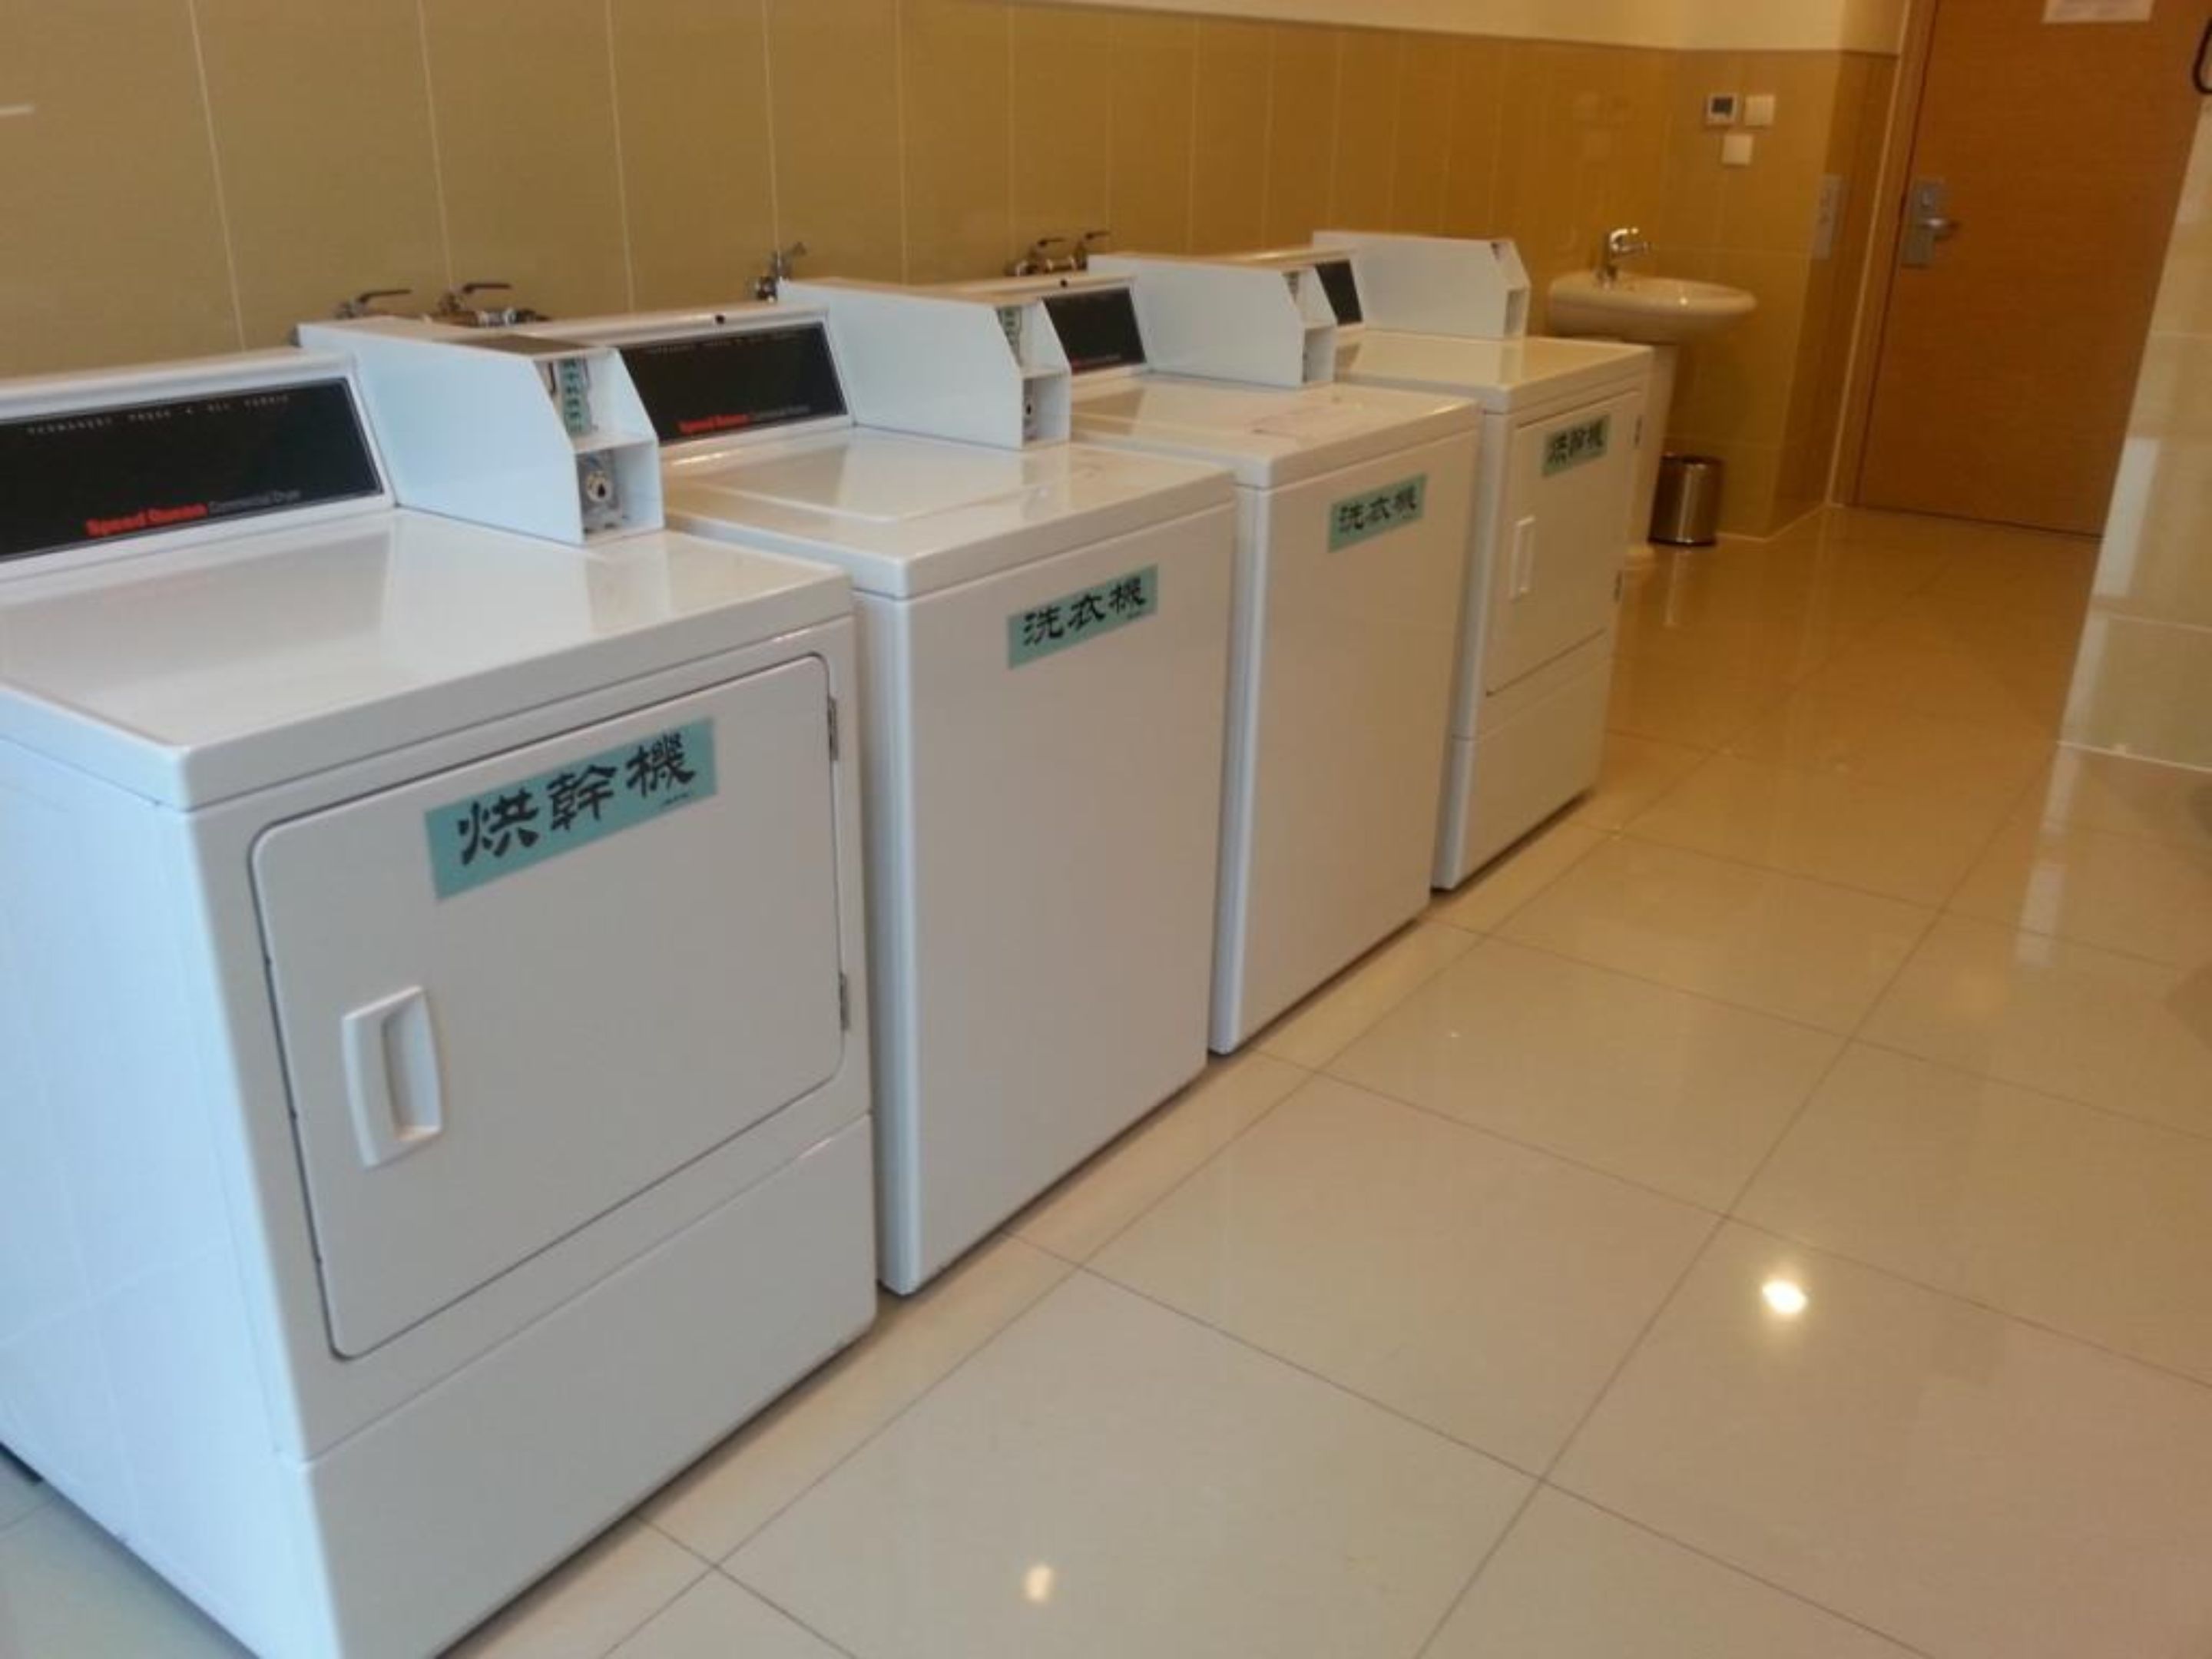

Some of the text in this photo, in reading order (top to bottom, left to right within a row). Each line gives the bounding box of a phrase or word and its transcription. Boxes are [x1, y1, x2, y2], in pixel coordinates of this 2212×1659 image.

[86, 511, 146, 537] Speed
[148, 503, 208, 525] Queen
[1339, 485, 1417, 533] 洗衣機
[1023, 577, 1147, 646] 洗衣機
[457, 732, 696, 866] 烘幹機
